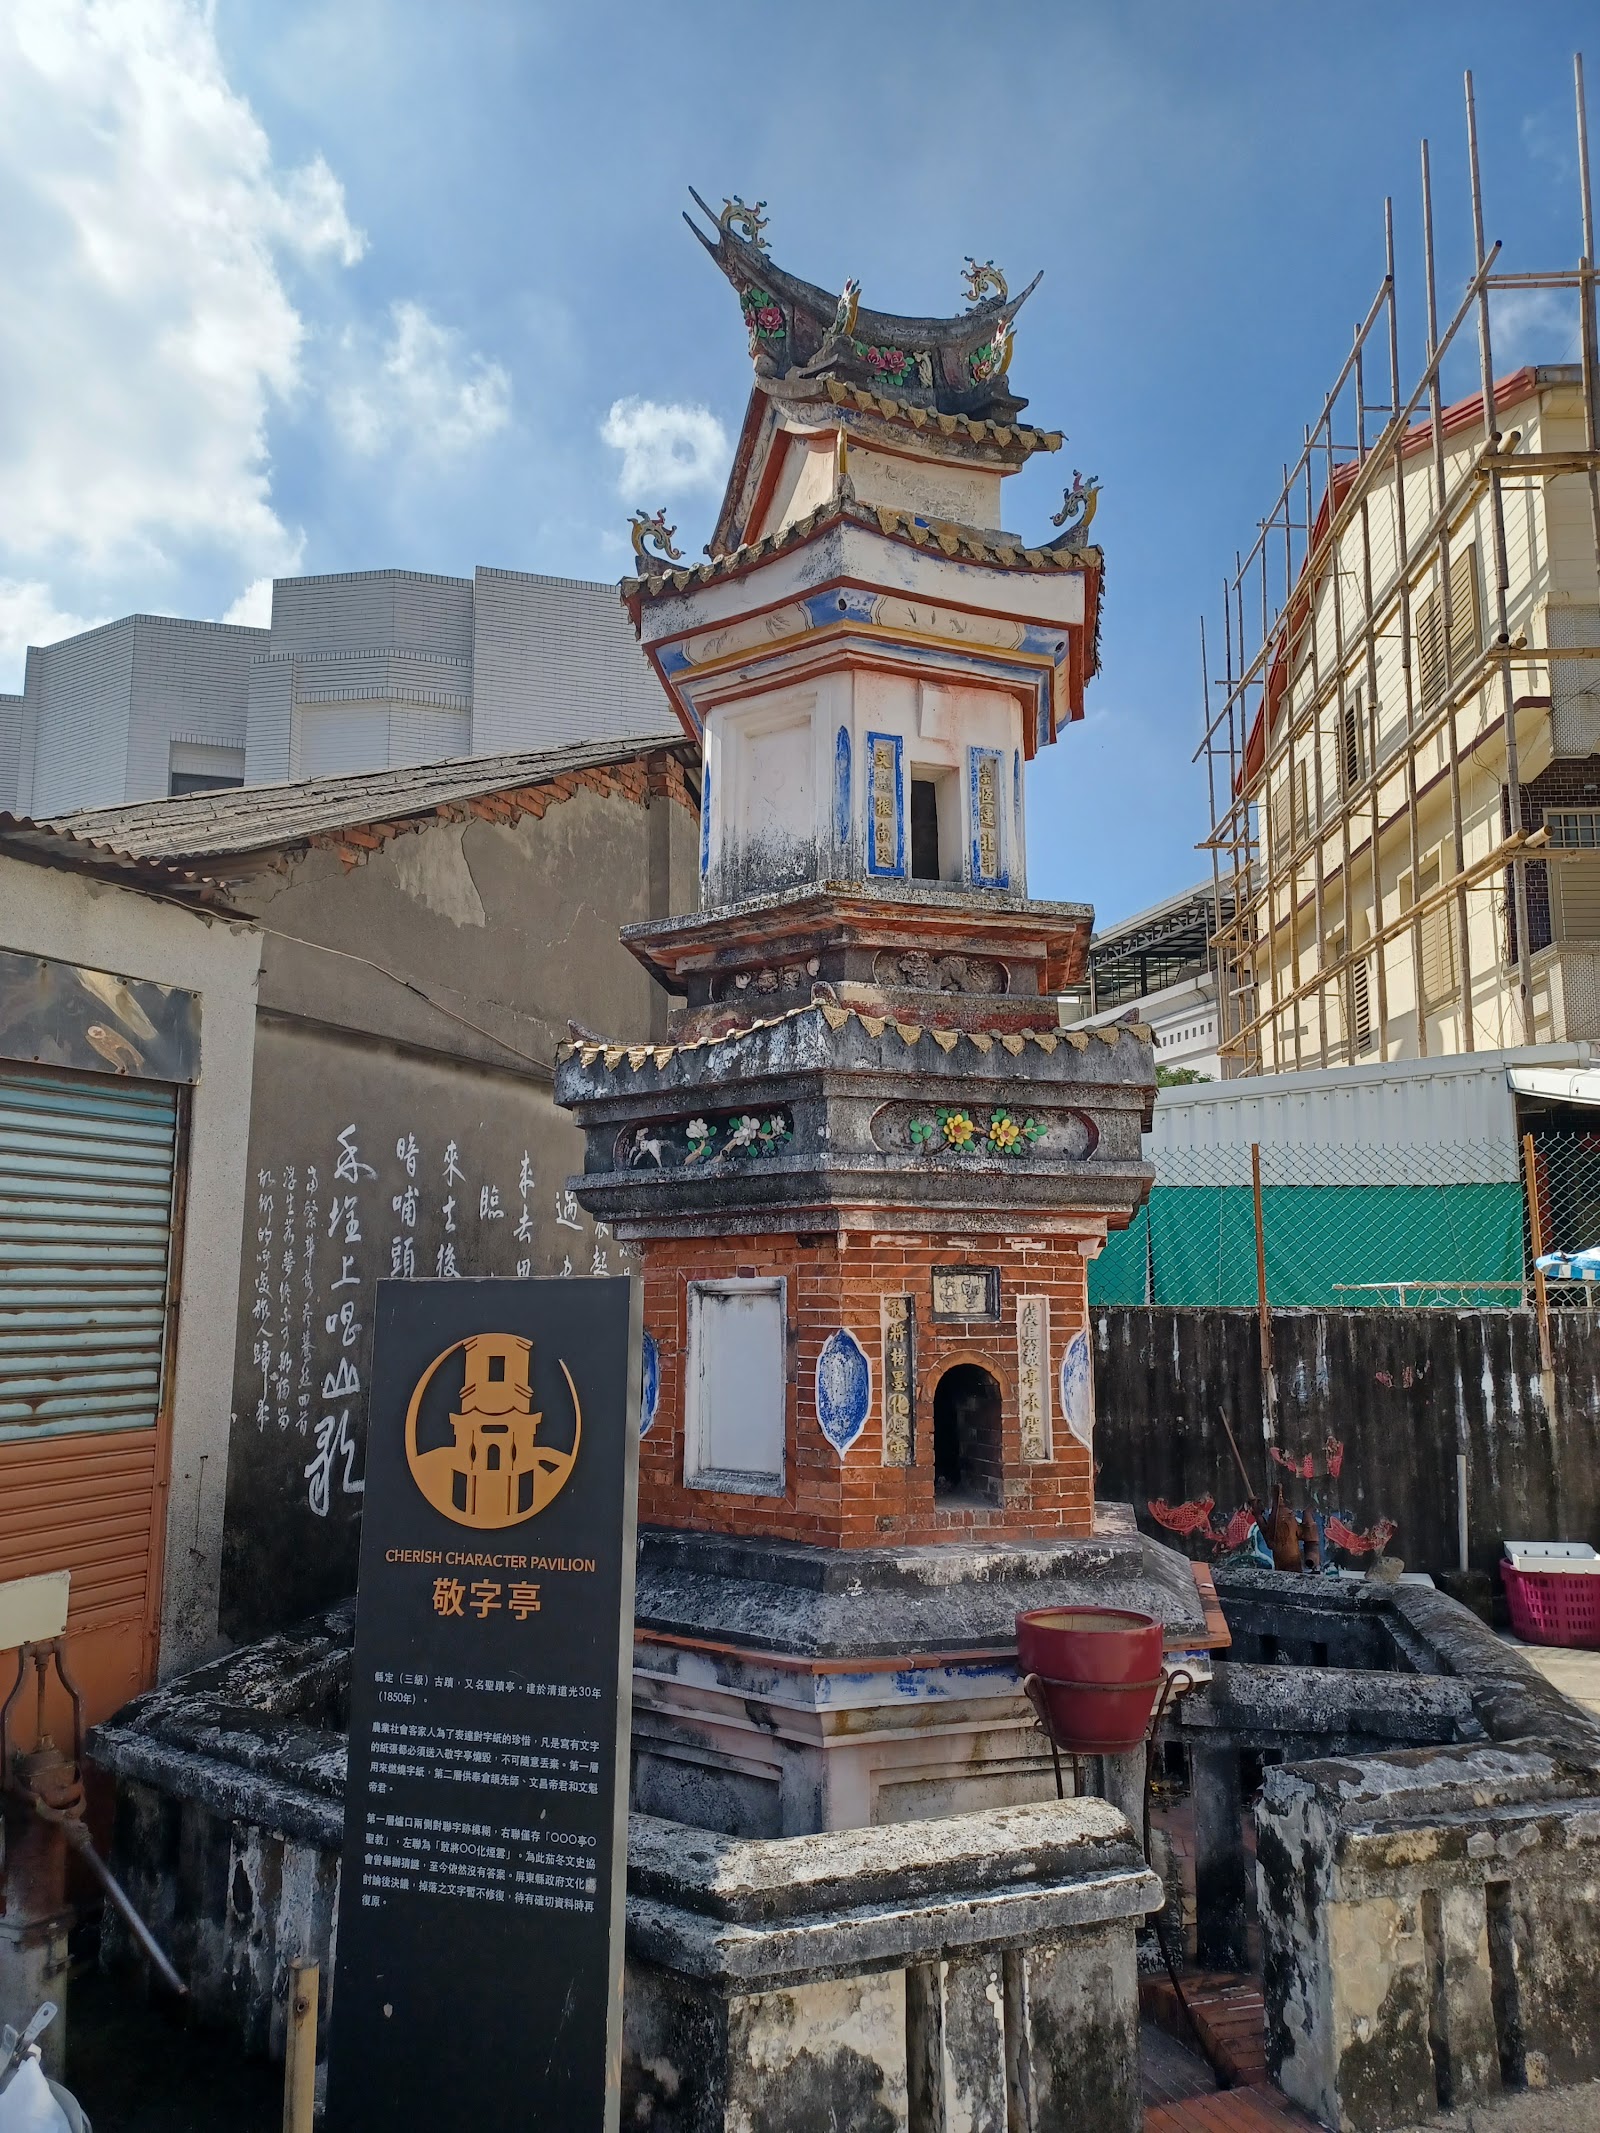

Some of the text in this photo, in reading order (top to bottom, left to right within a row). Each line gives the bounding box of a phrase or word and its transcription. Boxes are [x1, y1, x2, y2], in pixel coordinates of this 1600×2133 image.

[385, 1549, 596, 1573] CHERISH CHARACTER PAVILION
[432, 1577, 542, 1621] 敬字亭
